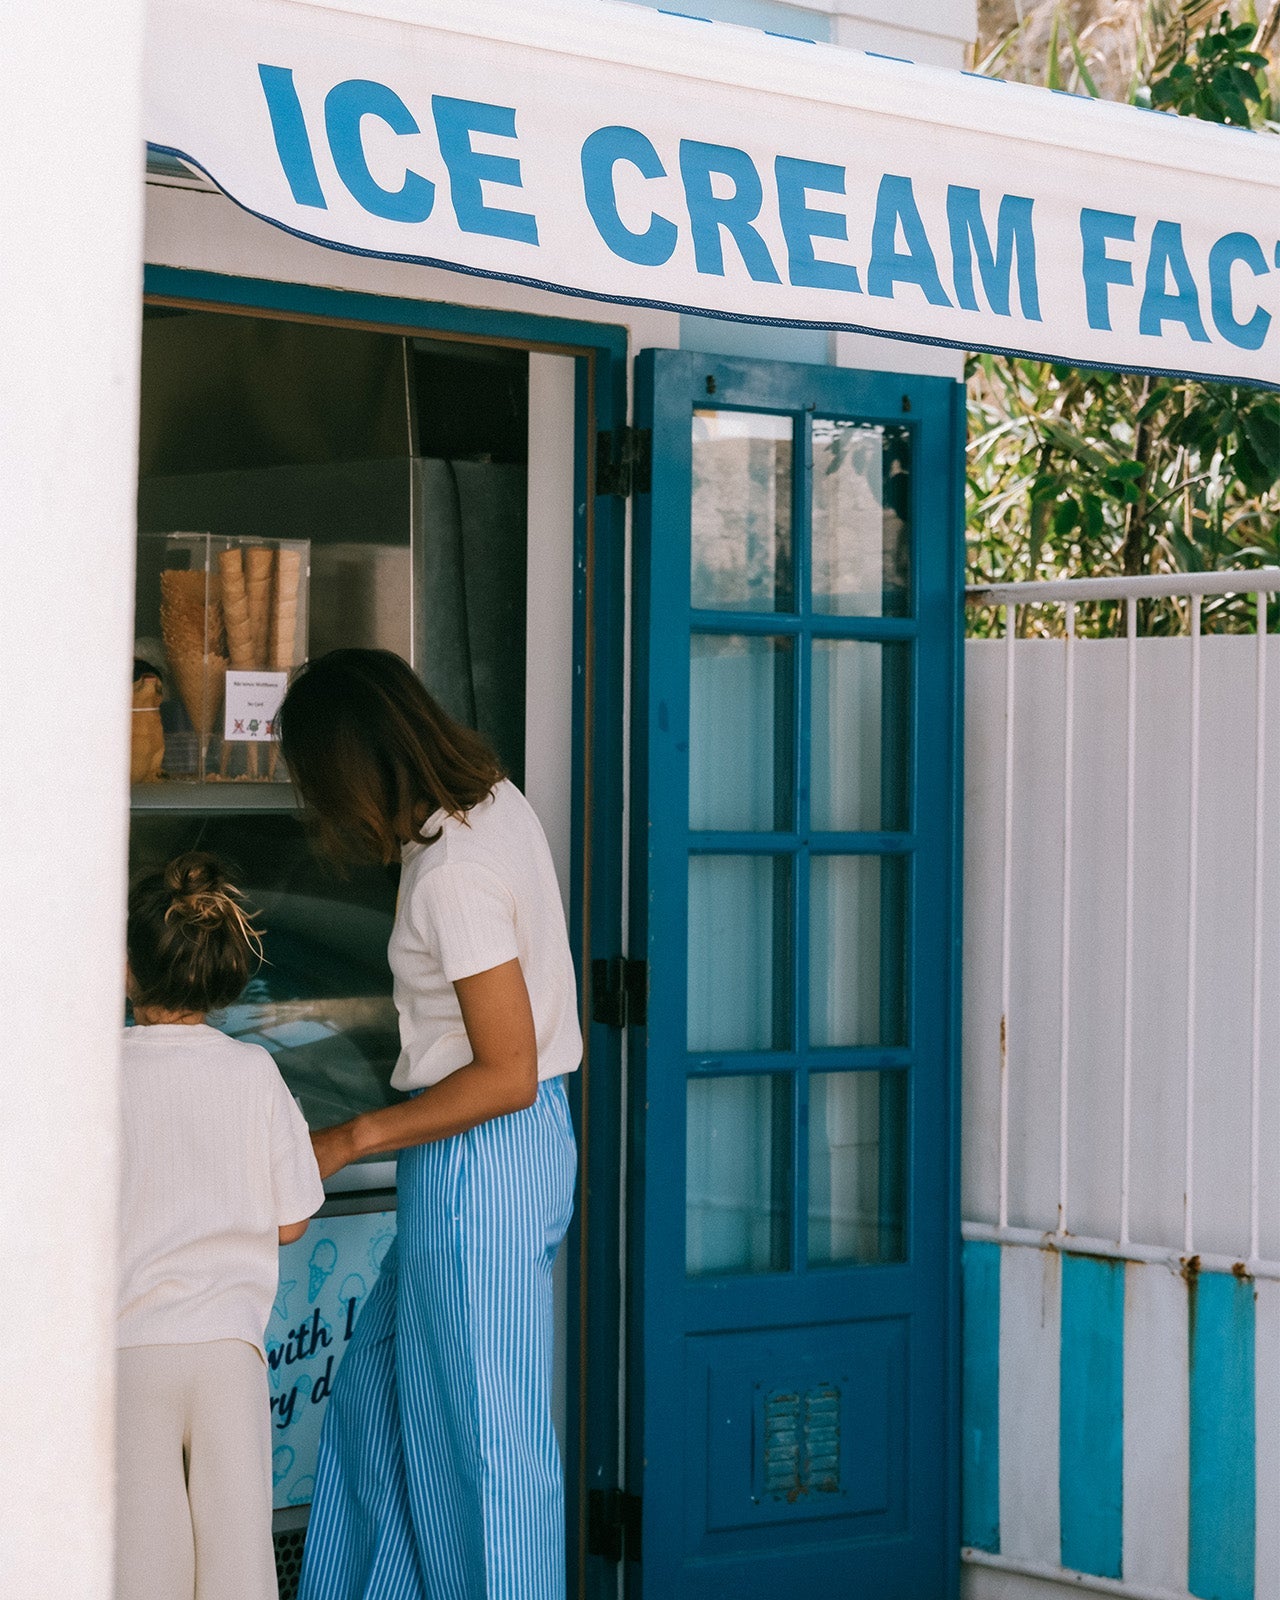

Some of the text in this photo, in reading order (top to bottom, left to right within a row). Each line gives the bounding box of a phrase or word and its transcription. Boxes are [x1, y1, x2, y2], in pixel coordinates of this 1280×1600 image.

[258, 64, 1280, 351] ICE CREAM FAC
